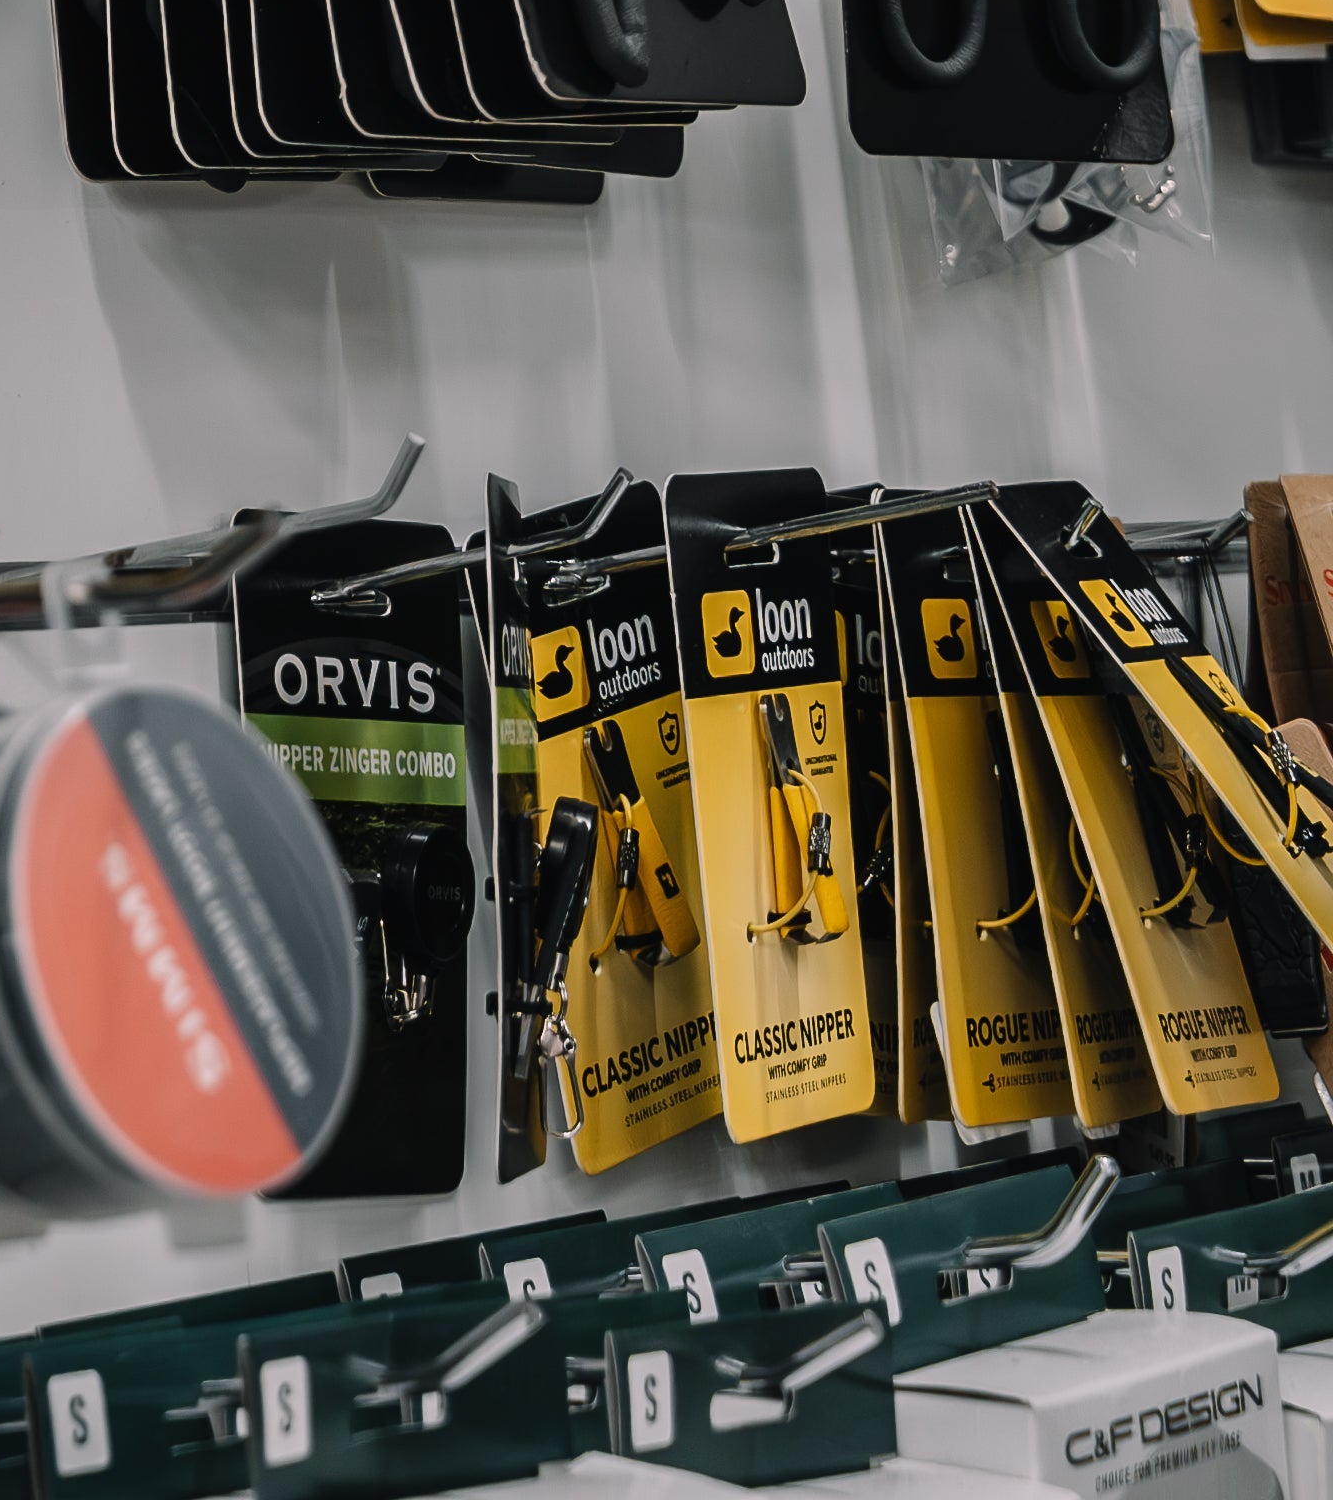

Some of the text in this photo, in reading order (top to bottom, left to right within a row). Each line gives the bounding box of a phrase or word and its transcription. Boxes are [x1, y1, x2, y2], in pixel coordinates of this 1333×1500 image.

[756, 587, 813, 645] loon
[1109, 577, 1172, 624] loon
[586, 612, 658, 674] loon
[761, 646, 815, 673] outdoors
[274, 652, 436, 714] ORVIS
[597, 659, 662, 701] outdoors
[329, 746, 457, 779] ZINGER COMBO
[735, 1007, 855, 1065] CLASSIC NIPPER
[966, 1012, 1032, 1048] ROGUE
[1075, 1011, 1114, 1045] ROGUE
[1157, 1004, 1252, 1044] ROGUE NIPPER
[582, 1010, 716, 1099] CLASSIC NIPP
[767, 1052, 828, 1081] WITH COMFY GRIP
[625, 1058, 702, 1104] WITH COMFY GRIP
[765, 1072, 847, 1104] STAINLESS STEEL NIPPERS
[625, 1099, 668, 1128] STAINLESS
[1161, 1266, 1175, 1311] S
[68, 1393, 90, 1447] S
[277, 1380, 293, 1435] S
[643, 1372, 658, 1424] S
[1064, 1372, 1266, 1467] C&F DESIGN
[1154, 1445, 1199, 1476] PREMIUM
